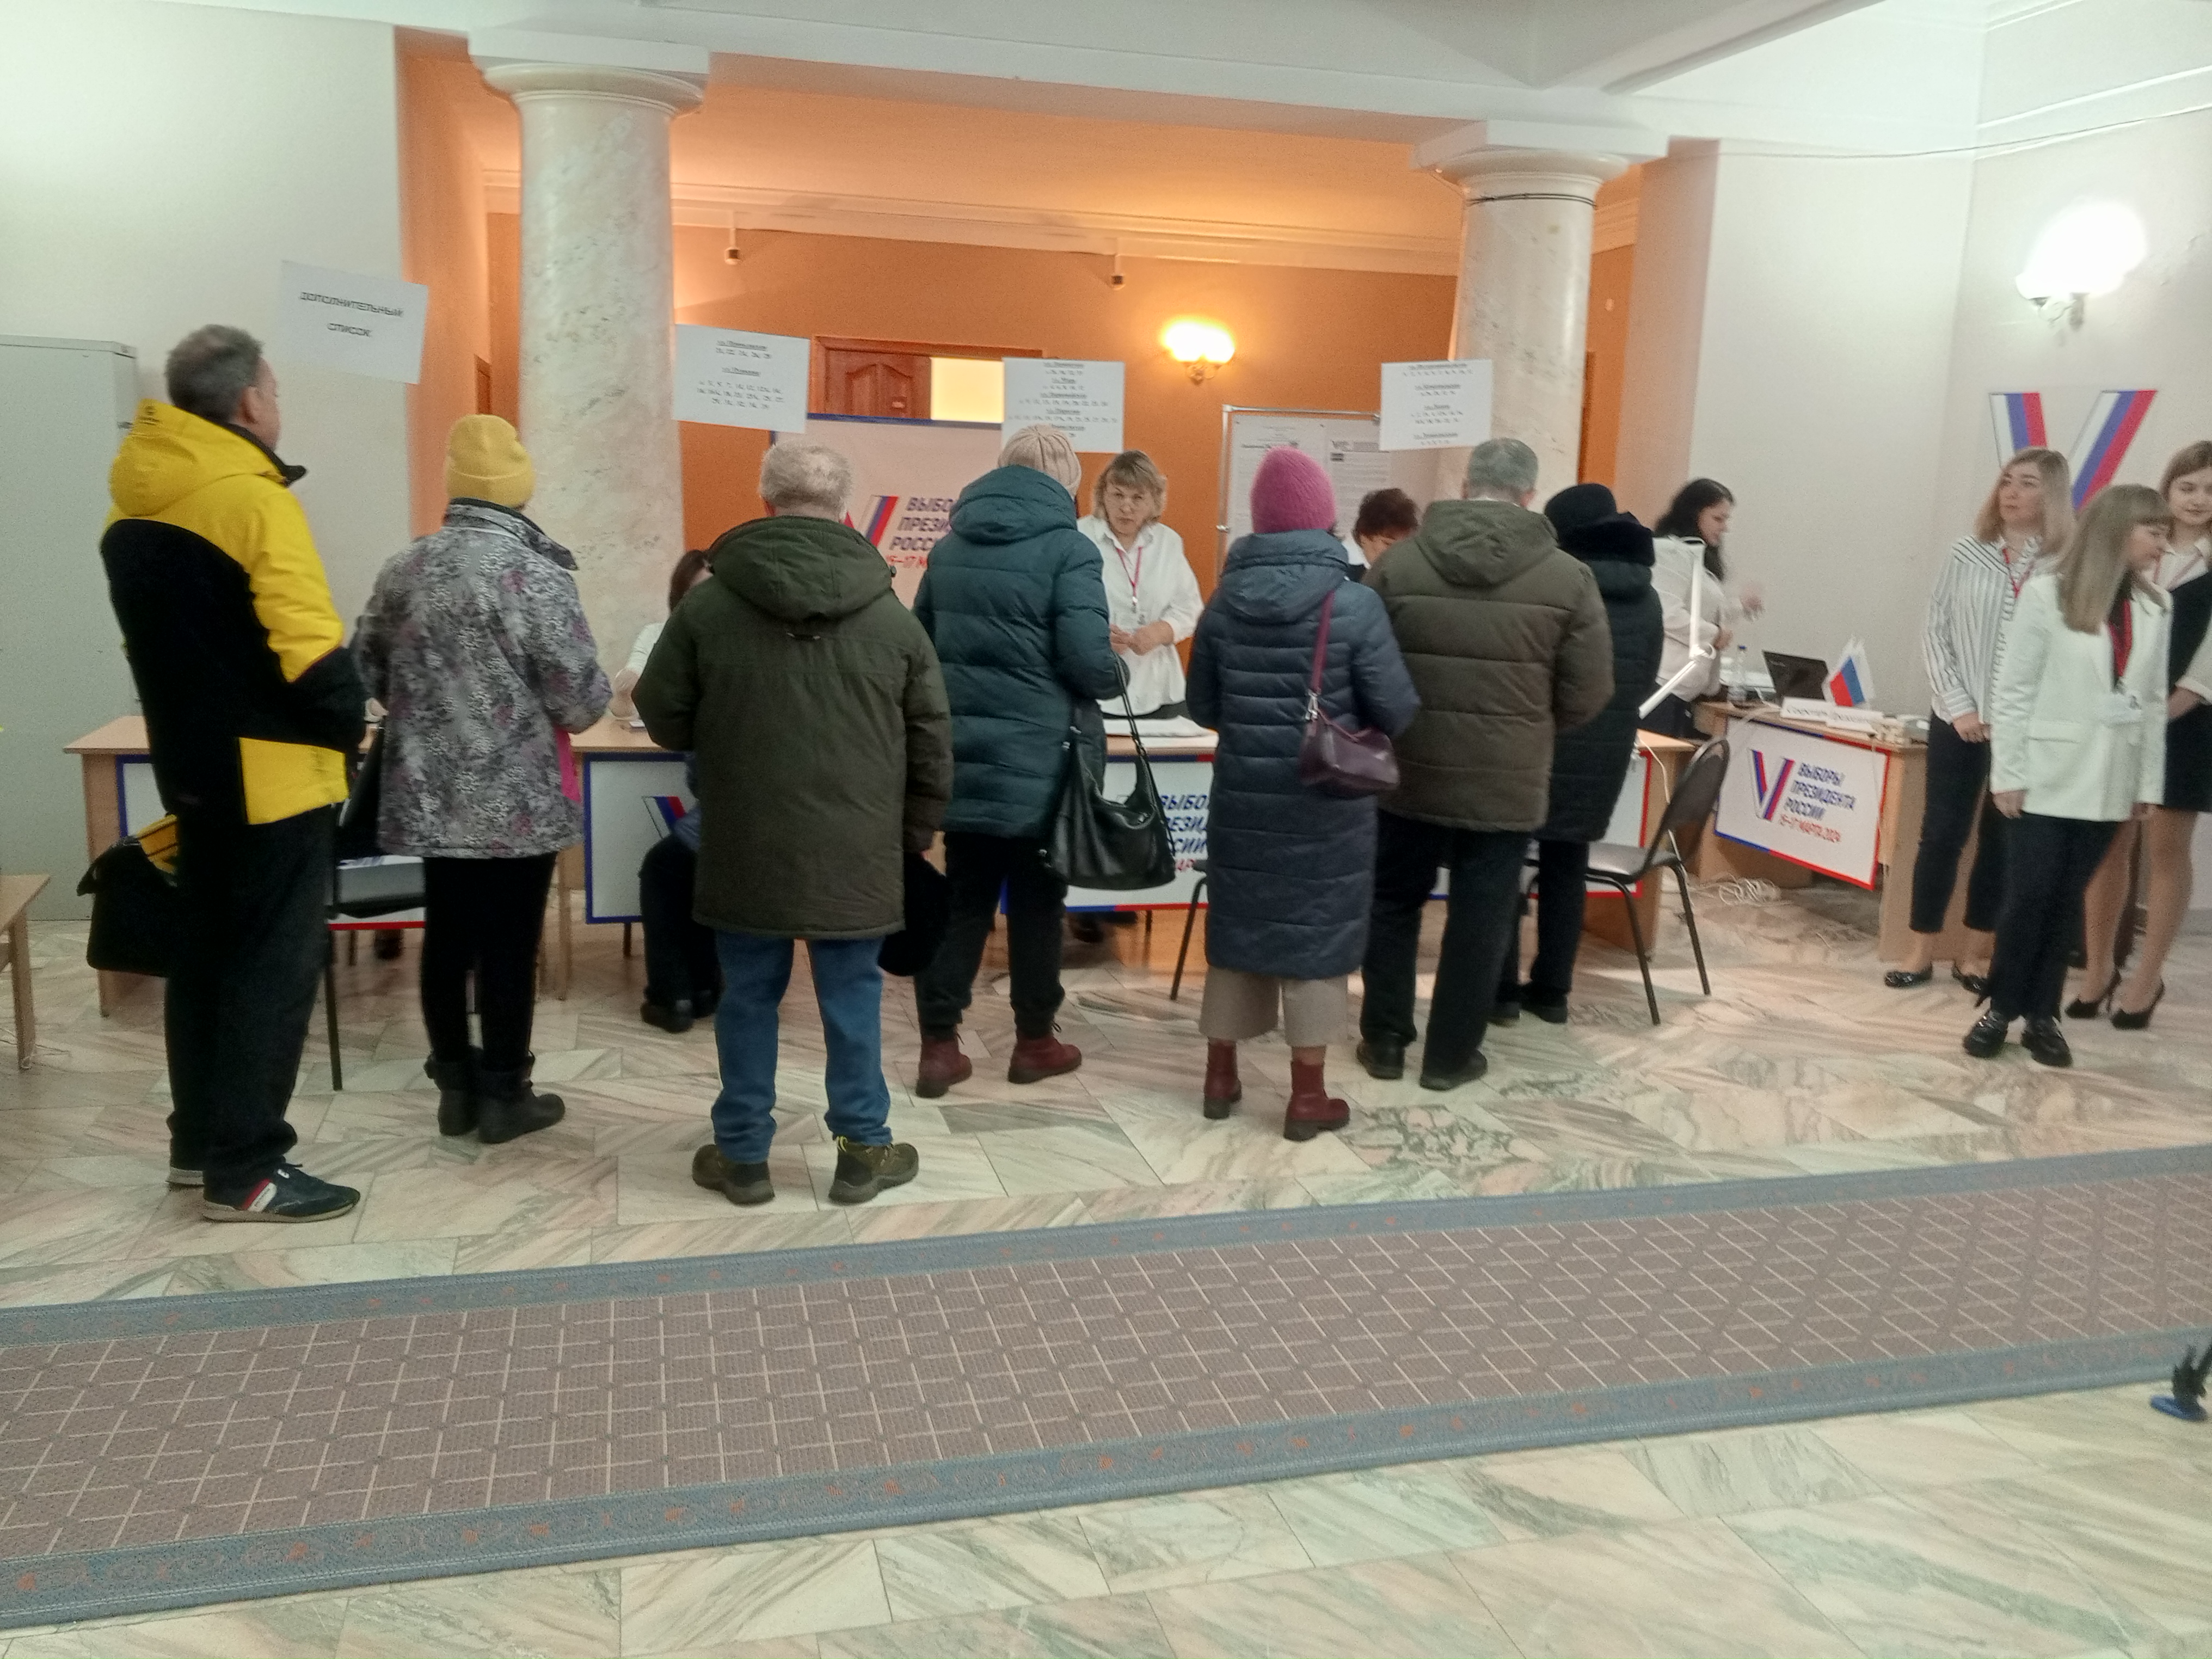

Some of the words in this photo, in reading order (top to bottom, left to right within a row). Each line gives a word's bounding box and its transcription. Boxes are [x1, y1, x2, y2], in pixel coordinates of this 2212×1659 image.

[300, 291, 404, 317] ДОПОЛНИТЕЛЬНЫЙ
[327, 322, 372, 337] СПИСОК
[907, 496, 953, 512] ВЫБО
[898, 517, 952, 532] ПРЕЗИ
[889, 536, 936, 551] РОСС
[1797, 763, 1846, 787] ВЫБОРЫ
[1160, 795, 1208, 810] ВЫБО
[1790, 780, 1857, 811] ПРЕЗИДЕНТА
[1784, 797, 1826, 821] РОССИИ
